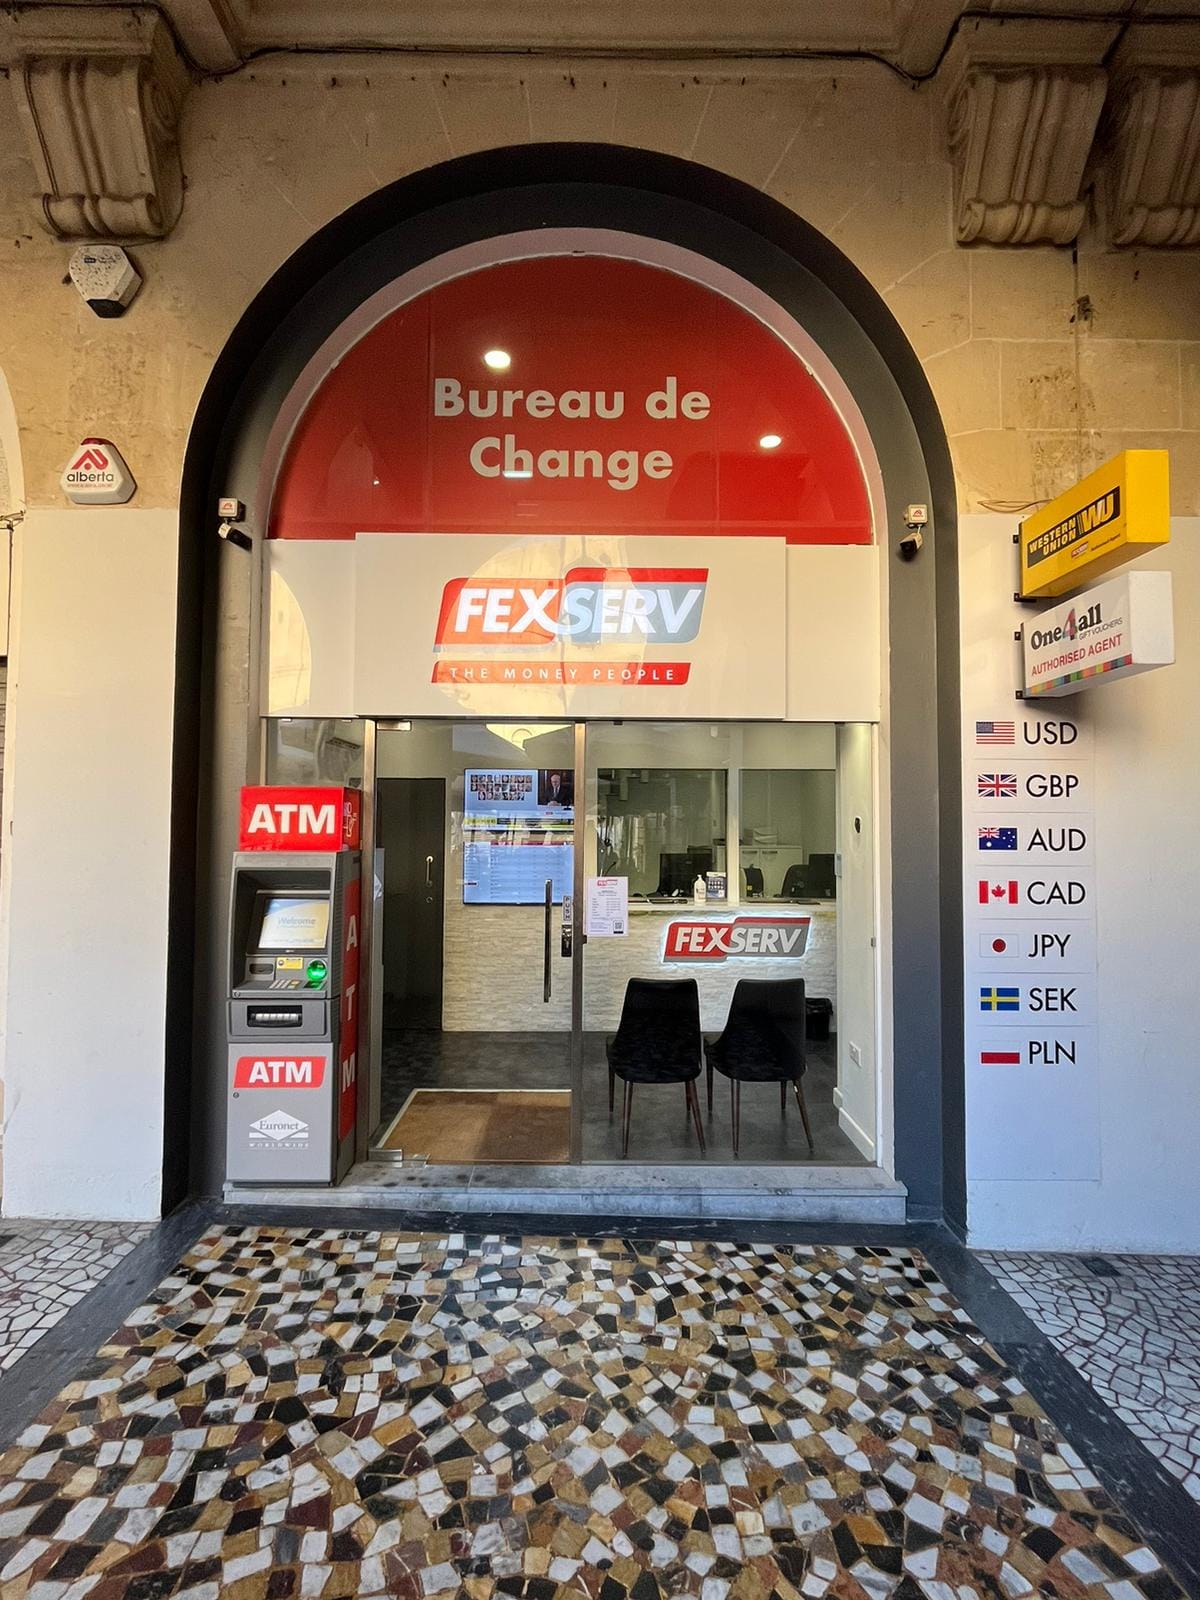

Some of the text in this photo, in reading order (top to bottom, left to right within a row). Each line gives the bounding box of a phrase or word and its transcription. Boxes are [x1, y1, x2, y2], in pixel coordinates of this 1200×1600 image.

[434, 376, 711, 419] Bureau de
[470, 434, 673, 491] Change
[67, 472, 114, 482] alberta
[1081, 493, 1115, 532] WU
[1029, 516, 1076, 554] WESTERN
[1043, 528, 1076, 556] UNION
[454, 588, 702, 635] FEXSERV
[1031, 603, 1102, 650] One4all
[1091, 616, 1124, 635] VOUCHERS
[1032, 633, 1123, 676] AUTHORISED AGENT
[451, 667, 674, 680] THE MONEY PEOPLE
[1023, 721, 1078, 745] USD
[1026, 774, 1079, 798] GBP
[247, 804, 336, 834] ATM
[1027, 828, 1086, 851] AUD
[1027, 881, 1086, 905] CAD
[278, 916, 316, 925] Welcome
[675, 927, 802, 953] FEXSERV
[1028, 934, 1071, 958] JPY
[1028, 987, 1077, 1011] SEK
[1029, 1040, 1076, 1064] PLN
[248, 1061, 312, 1083] ATM
[260, 1121, 299, 1130] Euronet
